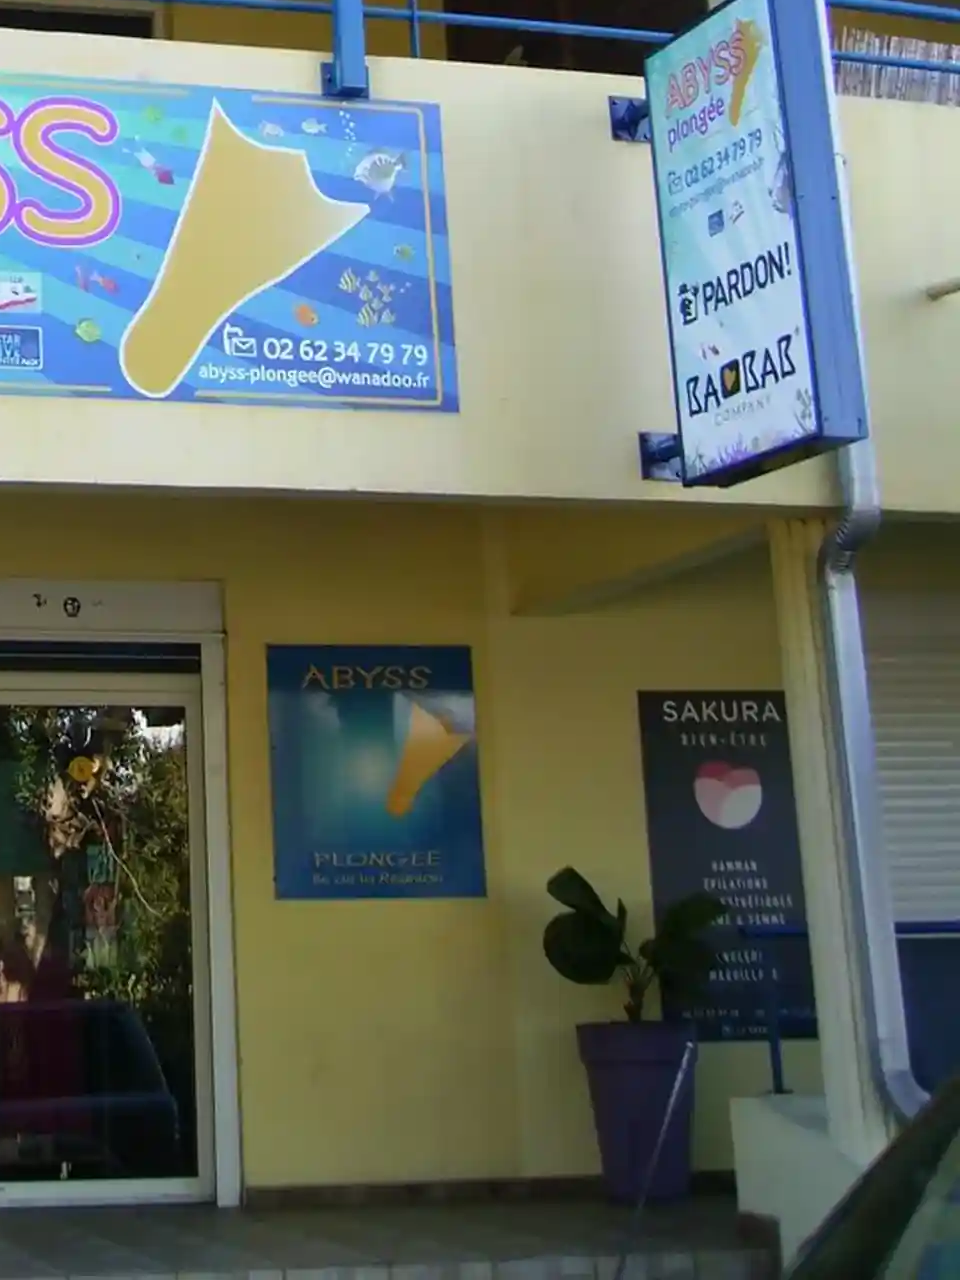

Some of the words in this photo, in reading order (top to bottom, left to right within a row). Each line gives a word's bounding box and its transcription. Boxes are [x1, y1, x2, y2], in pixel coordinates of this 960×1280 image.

[665, 30, 747, 119] ABYSS
[668, 96, 725, 152] plongée
[684, 163, 699, 188] 02
[700, 155, 715, 179] 62
[716, 148, 730, 171] 34
[731, 137, 746, 162] 79
[747, 128, 762, 153] 79
[703, 241, 792, 315] PARDON!
[263, 338, 294, 360] 02
[299, 339, 327, 362] 62
[333, 340, 362, 363] 34
[367, 342, 394, 365] 79
[400, 344, 428, 366] 79
[199, 363, 430, 389] abyss-plongee@wanadoo.fr
[302, 662, 433, 689] ABYSS
[662, 700, 782, 722] SAKURA
